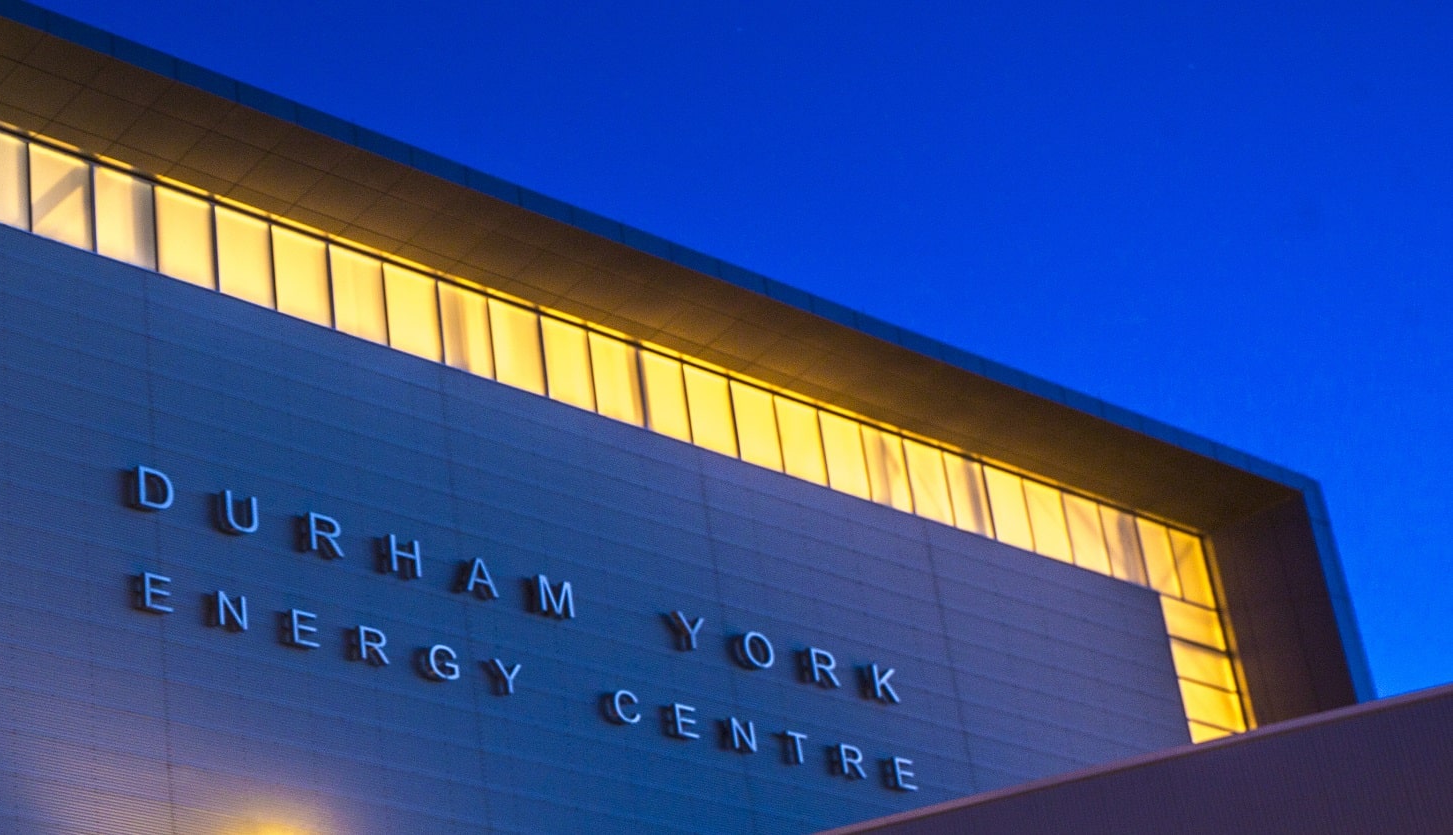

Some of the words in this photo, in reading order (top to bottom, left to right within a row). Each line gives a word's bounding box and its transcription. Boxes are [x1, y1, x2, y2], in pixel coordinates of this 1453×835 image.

[137, 465, 576, 619] DURHAM
[674, 610, 901, 703] YORK
[143, 571, 522, 695] ENERGY
[613, 689, 918, 791] CENTRE
